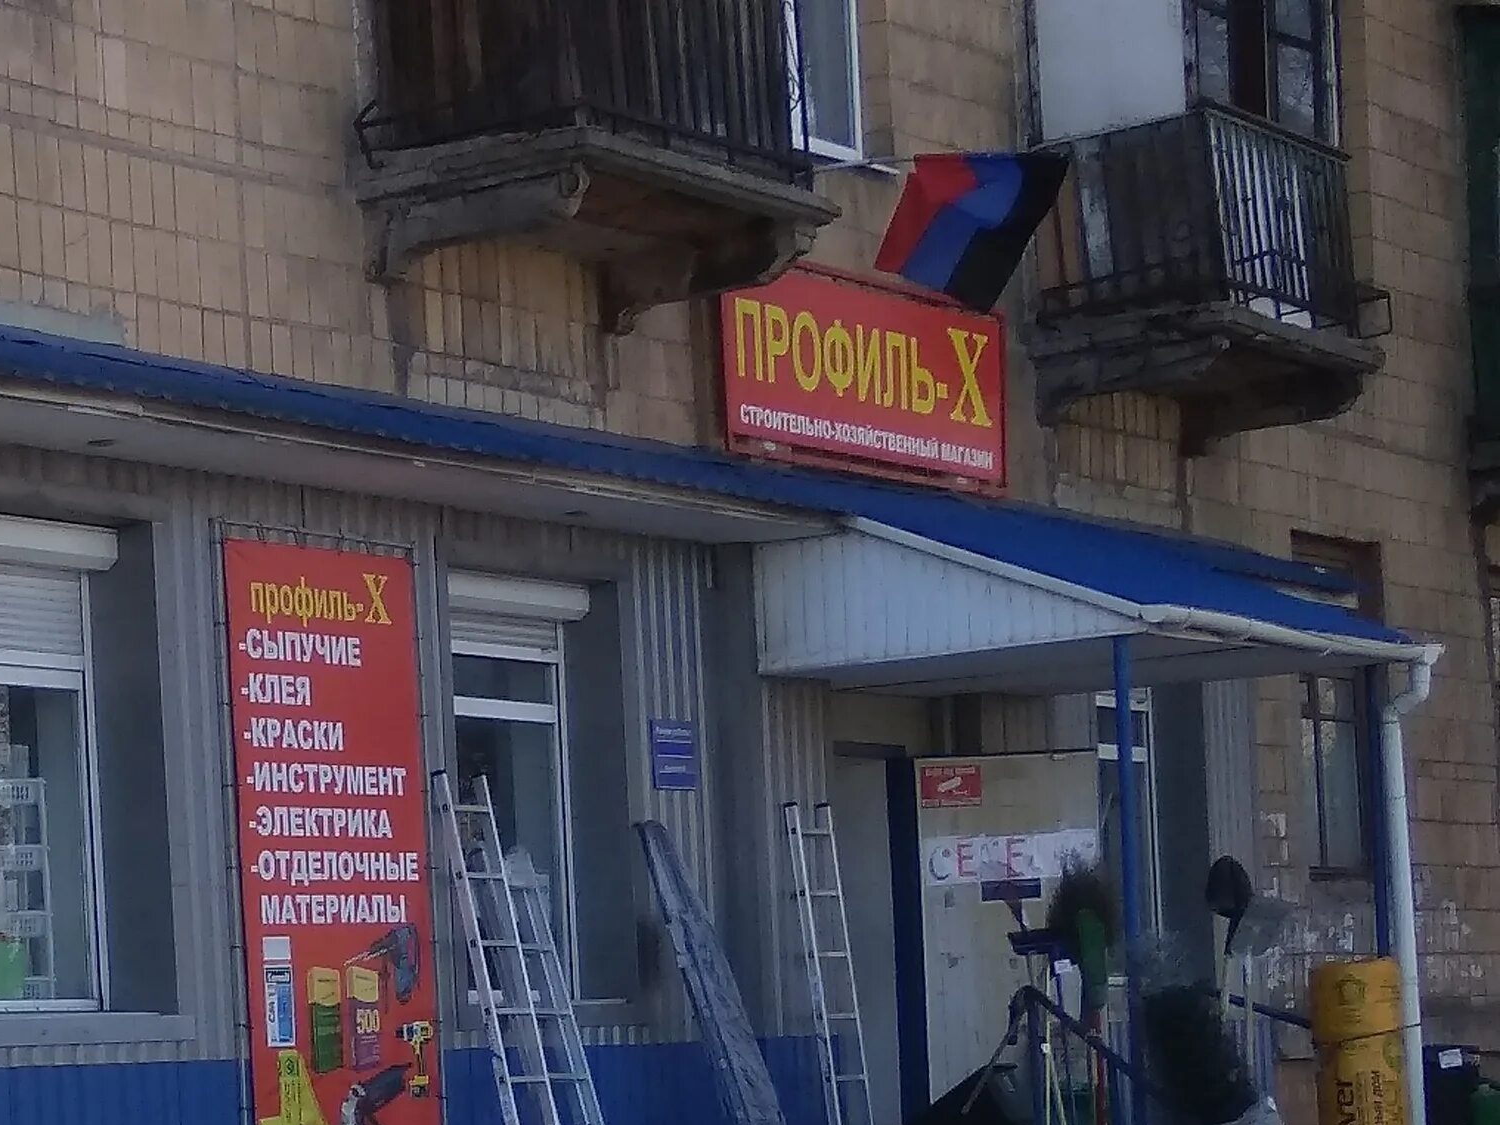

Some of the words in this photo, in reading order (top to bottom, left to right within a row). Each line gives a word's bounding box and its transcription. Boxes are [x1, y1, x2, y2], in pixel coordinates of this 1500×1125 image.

[734, 297, 993, 428] ПРОФИЛЬ-Х
[740, 403, 939, 458] СТРОИТЕЛЬНО-ХОЗЯЙСТВЕННЫЙ
[941, 441, 994, 470] МАГАЗИН
[239, 628, 362, 668] -СЫПУЧИЕ
[241, 672, 312, 707] -КЛЕЯ
[243, 717, 345, 752] -КРАСКИ
[246, 761, 407, 797] -ИНСТРУМЕНТ
[249, 806, 393, 839] -ЭЛЕКТРИКА
[251, 850, 420, 887] -ОТДЕЛОЧНЫЕ
[260, 894, 408, 925] МАТЕРИАЛЫ
[355, 1008, 381, 1034] 500
